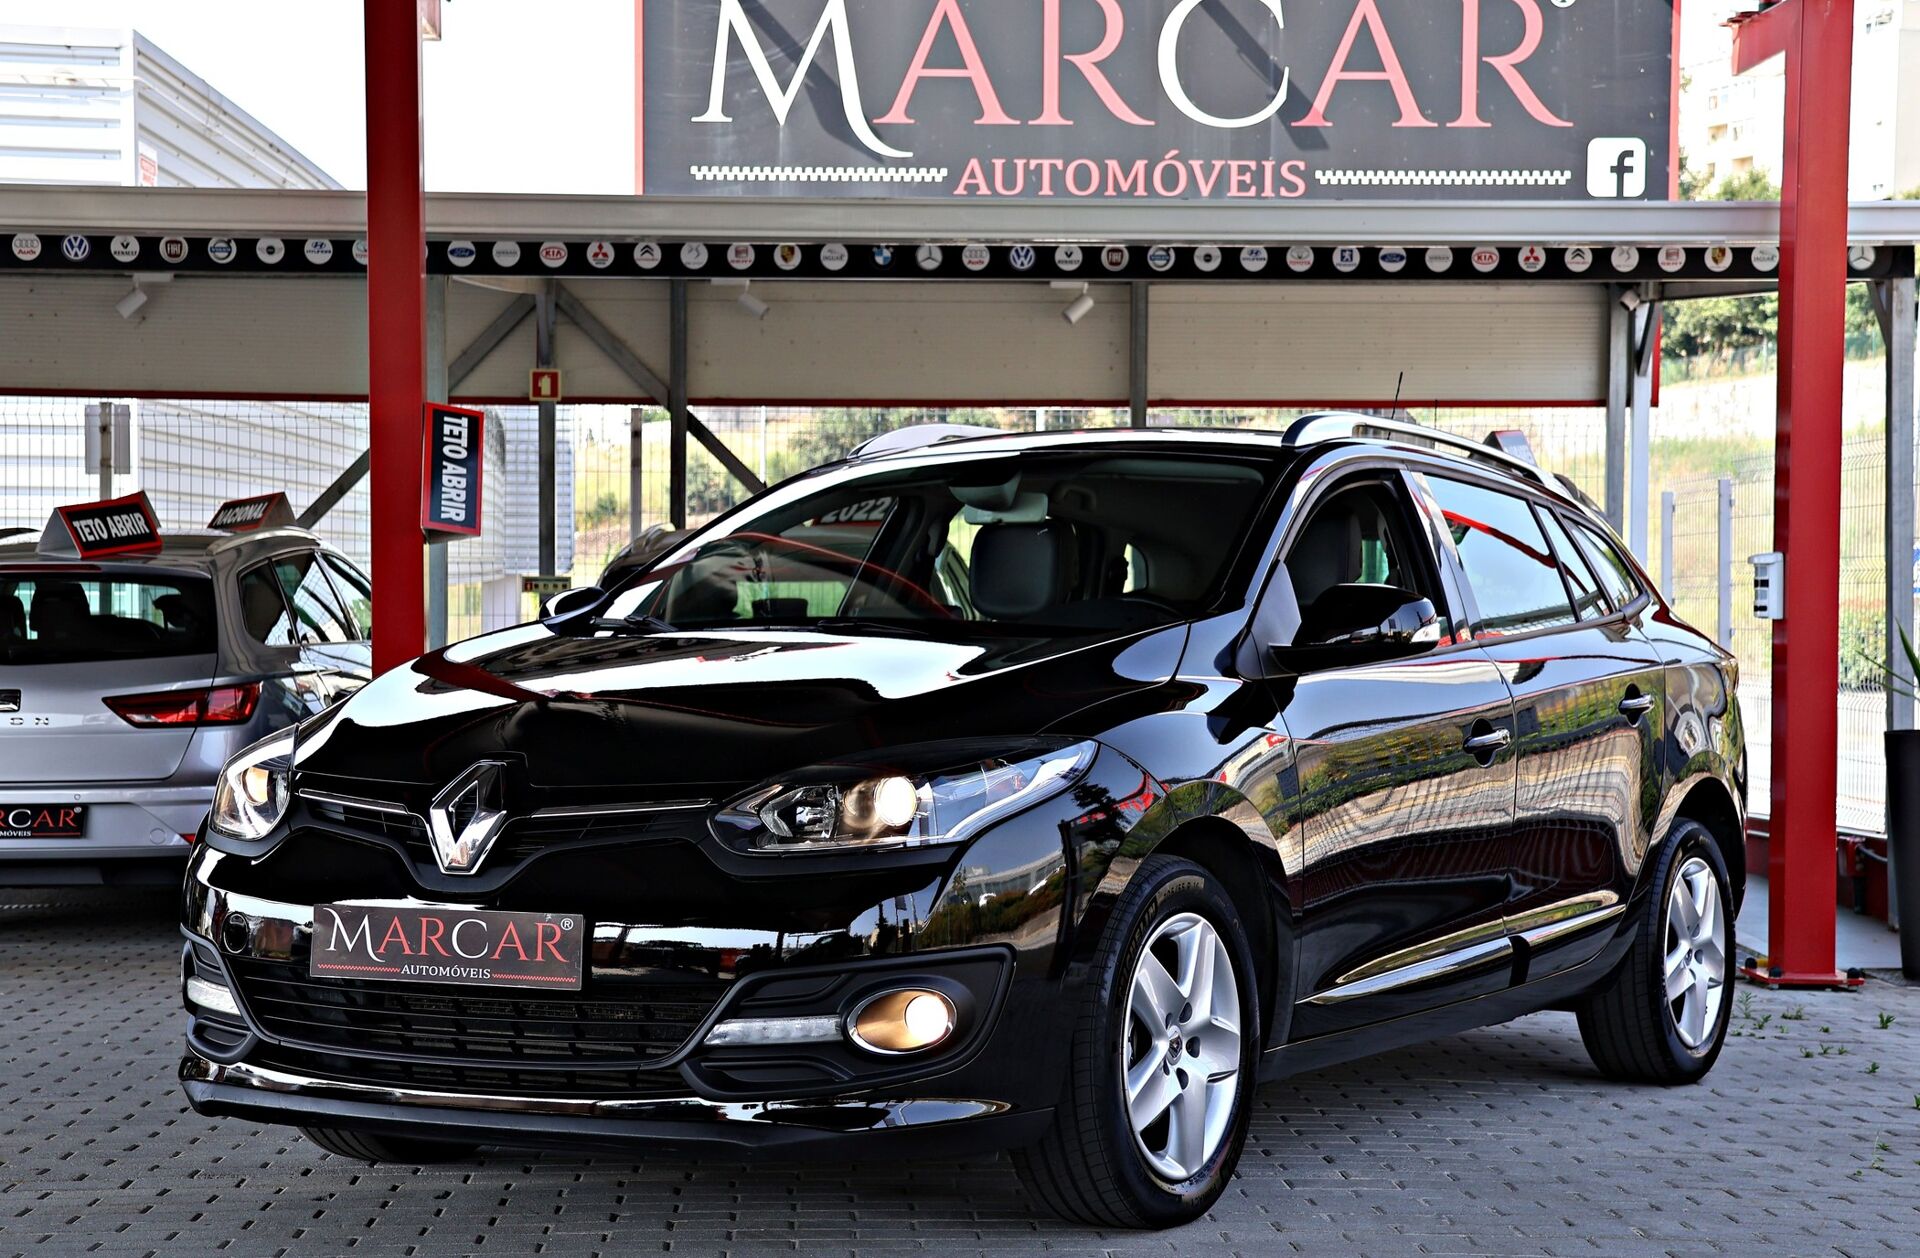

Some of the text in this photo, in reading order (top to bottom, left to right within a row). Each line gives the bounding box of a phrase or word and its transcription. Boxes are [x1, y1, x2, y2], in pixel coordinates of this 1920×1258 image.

[690, 0, 1574, 158] MARCAR
[953, 150, 1307, 197] AUTOMÓVEIS
[545, 249, 562, 257] KIA
[1476, 253, 1494, 261] KIA
[440, 415, 468, 522] TETO ABRIR
[72, 512, 150, 542] TETO ABRIR
[323, 907, 570, 963] MARCAR
[401, 964, 491, 980] AUTOMÓVEIS
